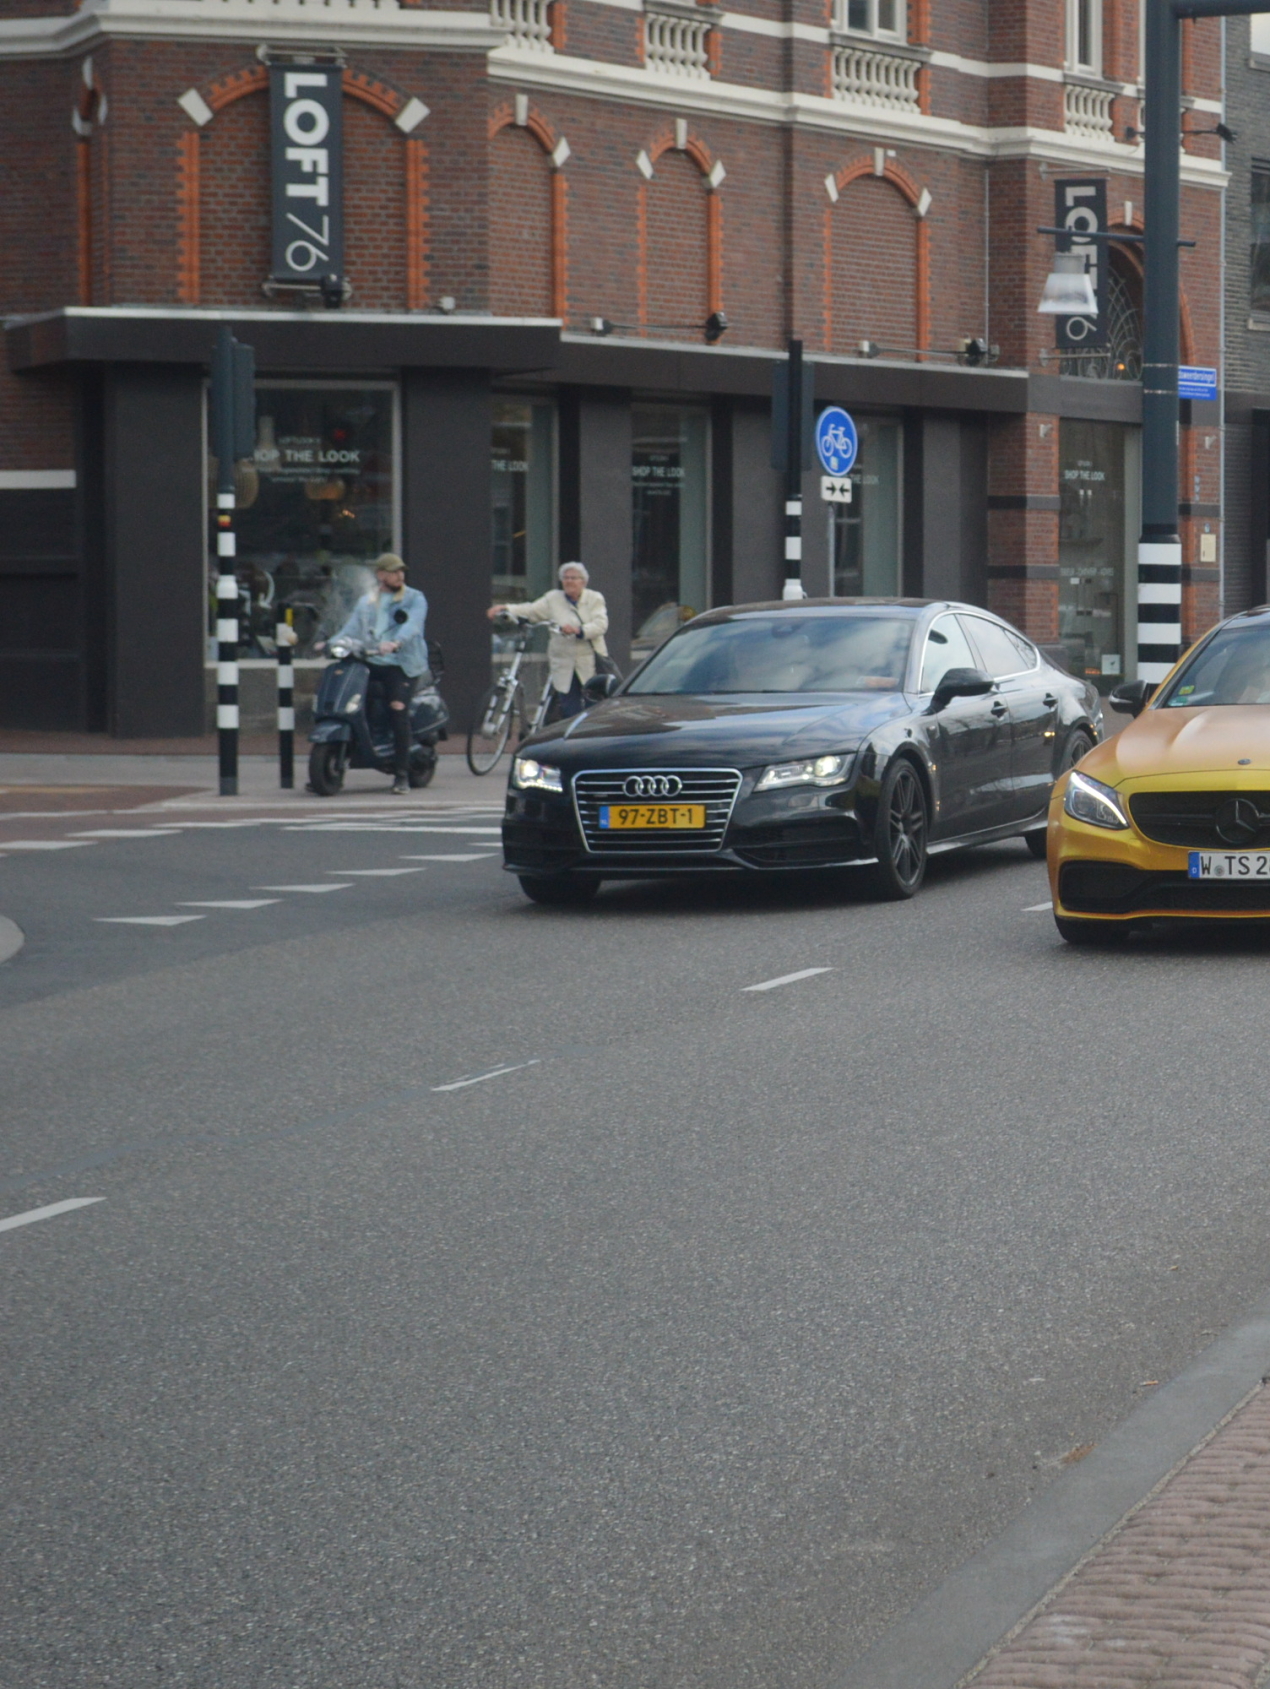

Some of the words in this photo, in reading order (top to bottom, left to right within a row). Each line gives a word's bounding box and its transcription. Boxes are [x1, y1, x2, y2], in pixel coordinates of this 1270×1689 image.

[284, 72, 330, 207] LOFT
[285, 212, 330, 272] 76
[284, 449, 314, 462] THE
[317, 449, 360, 462] LOOK
[618, 808, 693, 826] 97-ZBT-1
[1200, 856, 1212, 876] W
[1224, 855, 1251, 876] TS
